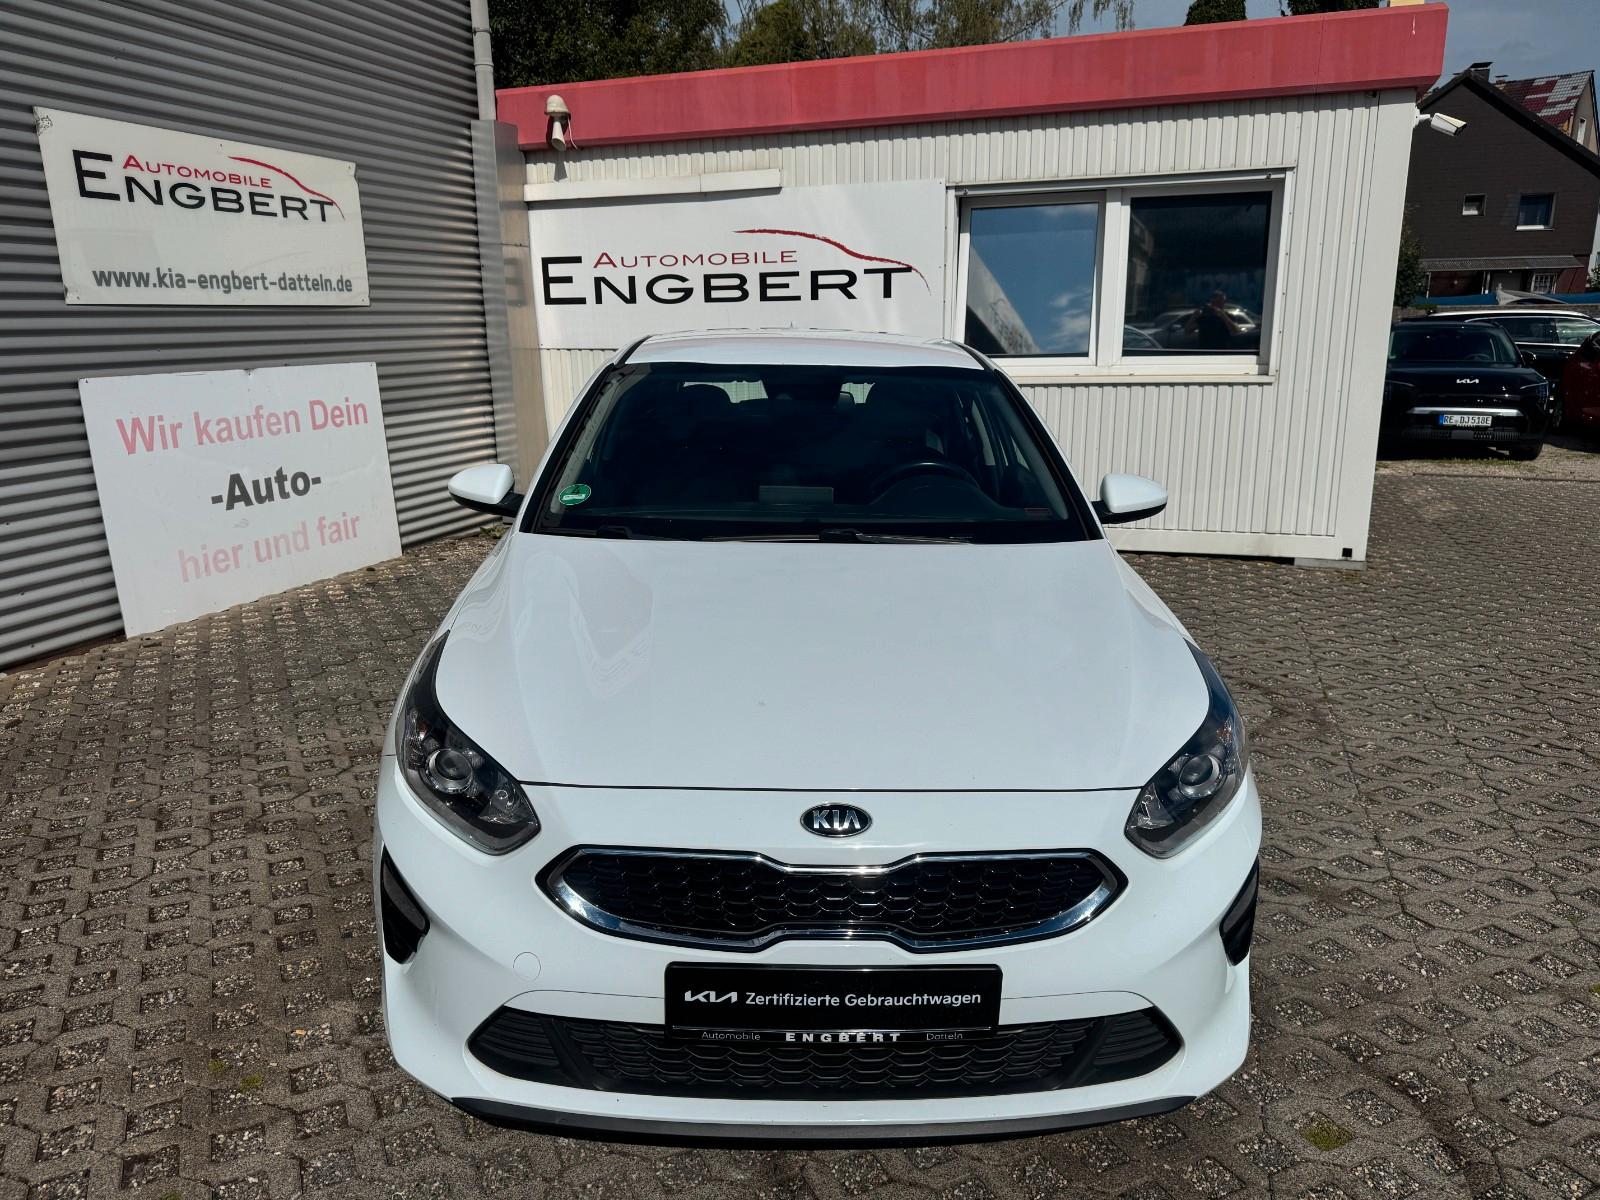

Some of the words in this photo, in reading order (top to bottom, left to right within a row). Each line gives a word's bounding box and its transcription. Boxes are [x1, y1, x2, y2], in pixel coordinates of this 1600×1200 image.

[72, 149, 334, 222] ENGBERT
[122, 154, 273, 189] AUTOMOBILE
[593, 250, 798, 269] AUTOMOBILE
[91, 267, 353, 295] www.kia-engbert-datteln.de
[541, 255, 913, 306] ENGBERT
[116, 415, 183, 456] Wir
[193, 405, 301, 446] kaufen
[308, 397, 369, 431] Dein
[210, 466, 323, 512] -Auto-
[178, 543, 244, 583] hier
[253, 521, 310, 563] und
[315, 511, 361, 547] fair
[812, 809, 861, 829] KIA
[745, 991, 840, 1007] Zertifizierte
[844, 992, 981, 1007] Gebrauchtwagen
[701, 1031, 761, 1041] Automobile
[785, 1031, 900, 1043] ENGBERT
